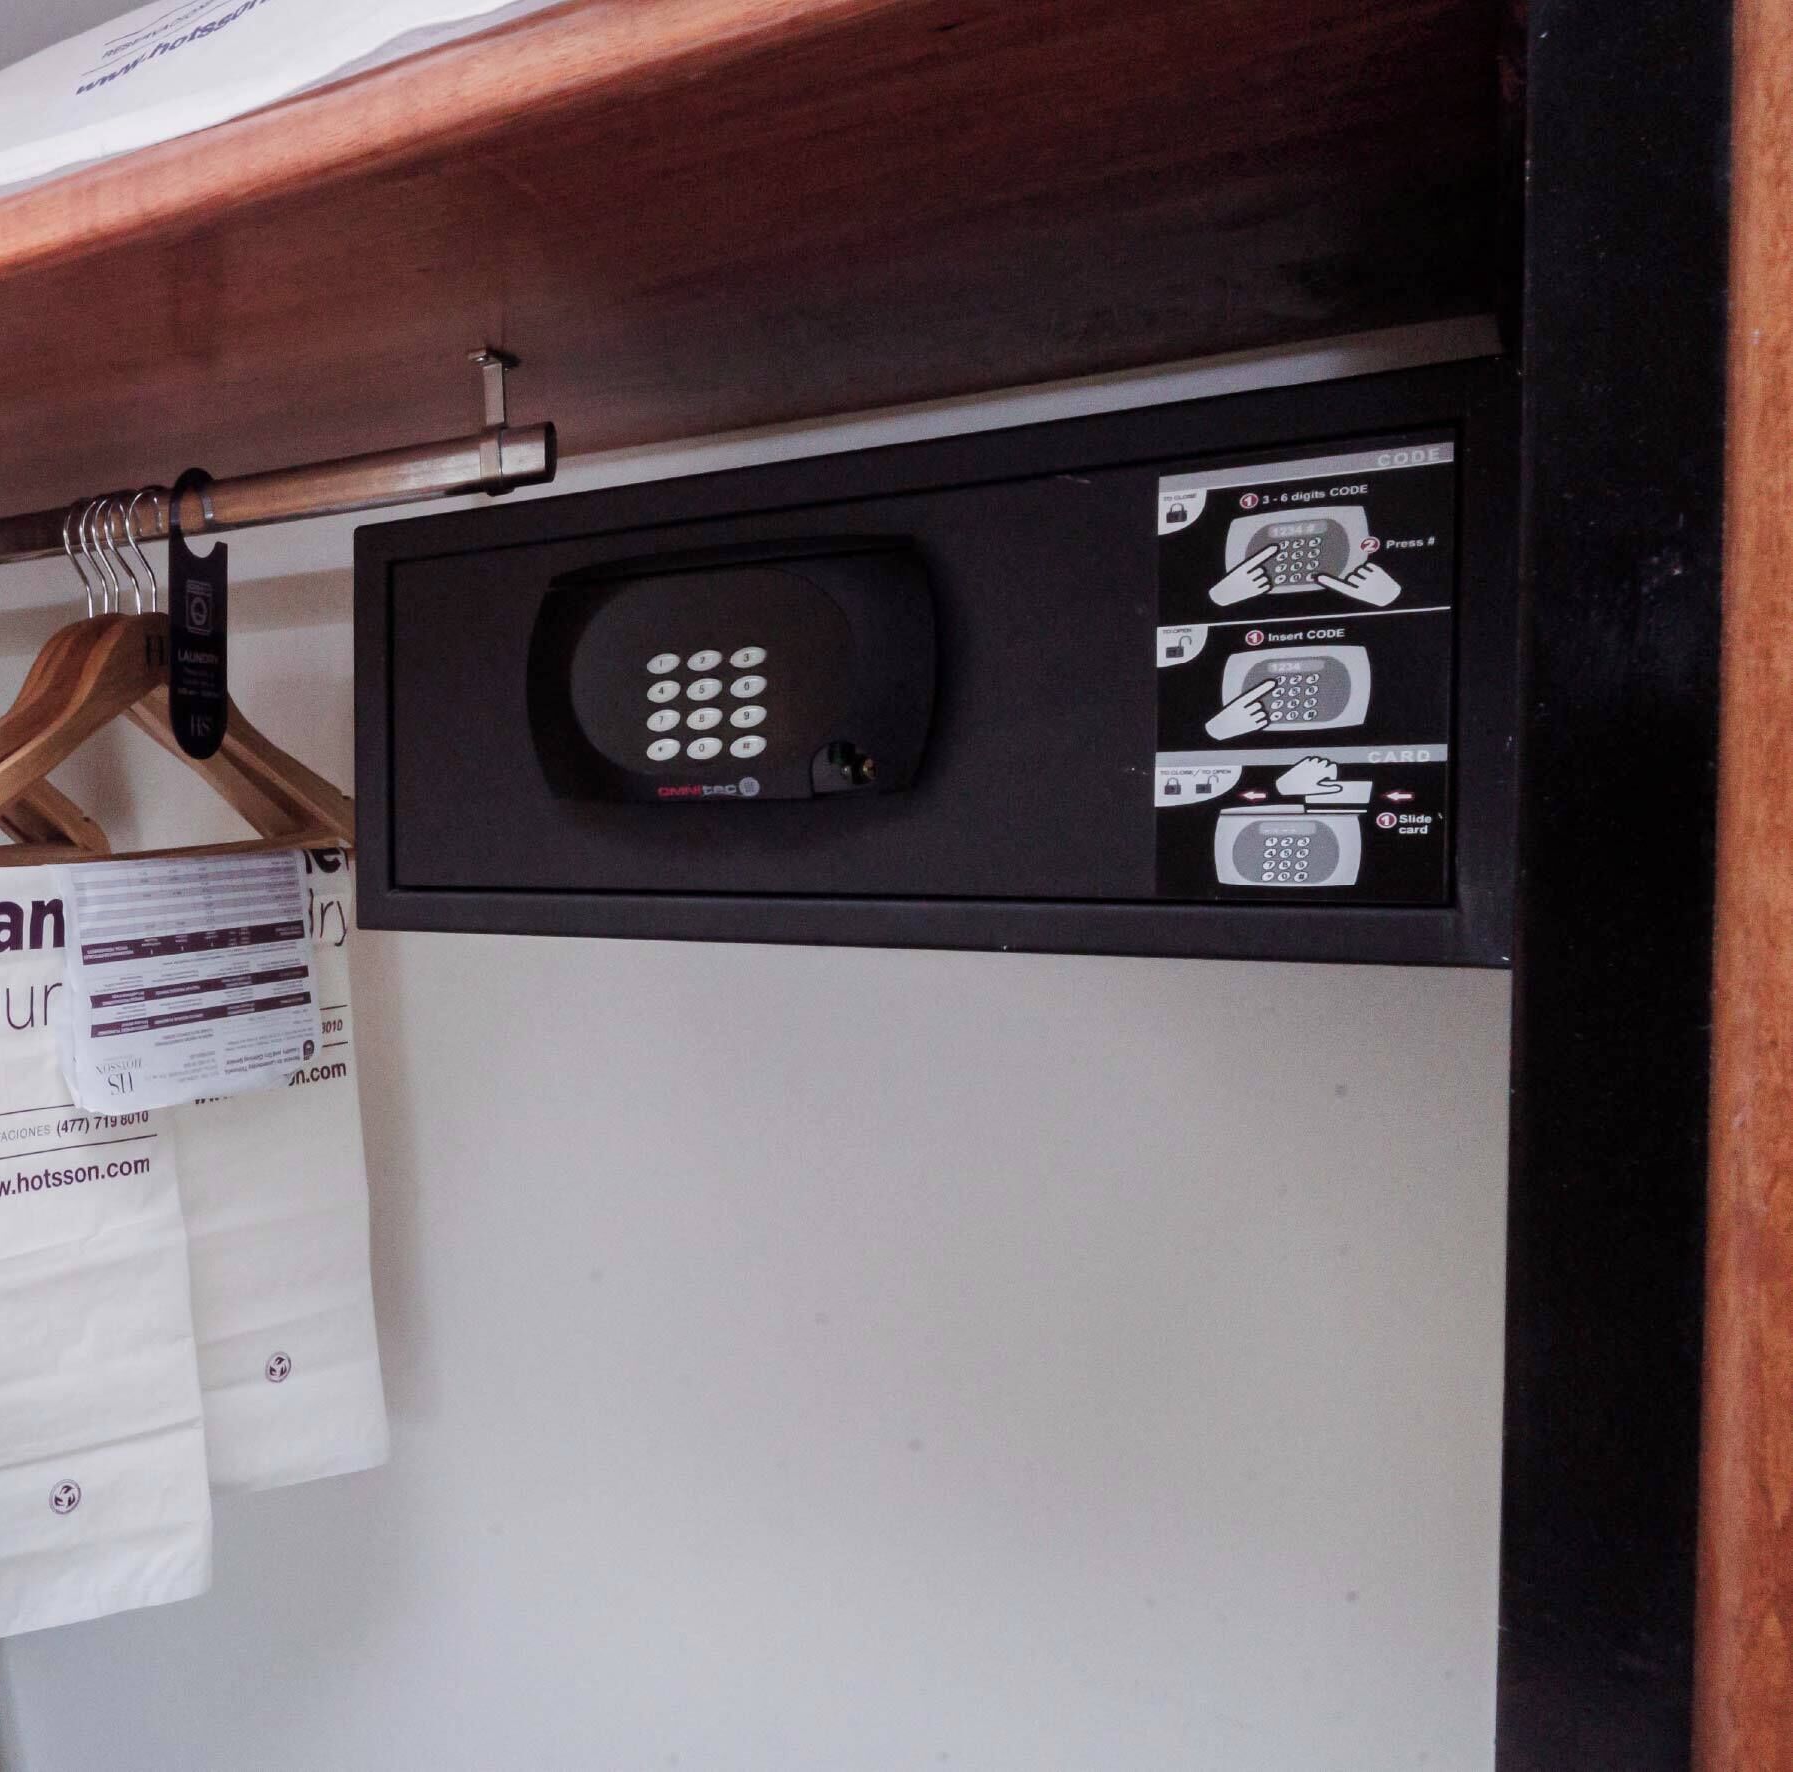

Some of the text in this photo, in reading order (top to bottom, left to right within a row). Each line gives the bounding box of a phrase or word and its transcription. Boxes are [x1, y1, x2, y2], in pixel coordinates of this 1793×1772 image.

[1377, 448, 1441, 467] CODE
[1262, 495, 1269, 505] 3
[1281, 493, 1288, 503] 6
[1291, 489, 1326, 504] digits
[1330, 484, 1368, 497] CODE
[1386, 538, 1423, 549] Press
[1268, 632, 1303, 642] Insert
[1306, 629, 1345, 640] CODE
[1367, 750, 1431, 764] CARD
[1399, 814, 1432, 824] Slide
[1398, 824, 1428, 835] card
[56, 1116, 90, 1137] (477)
[94, 1113, 118, 1130] 719
[120, 1110, 149, 1124] 8010
